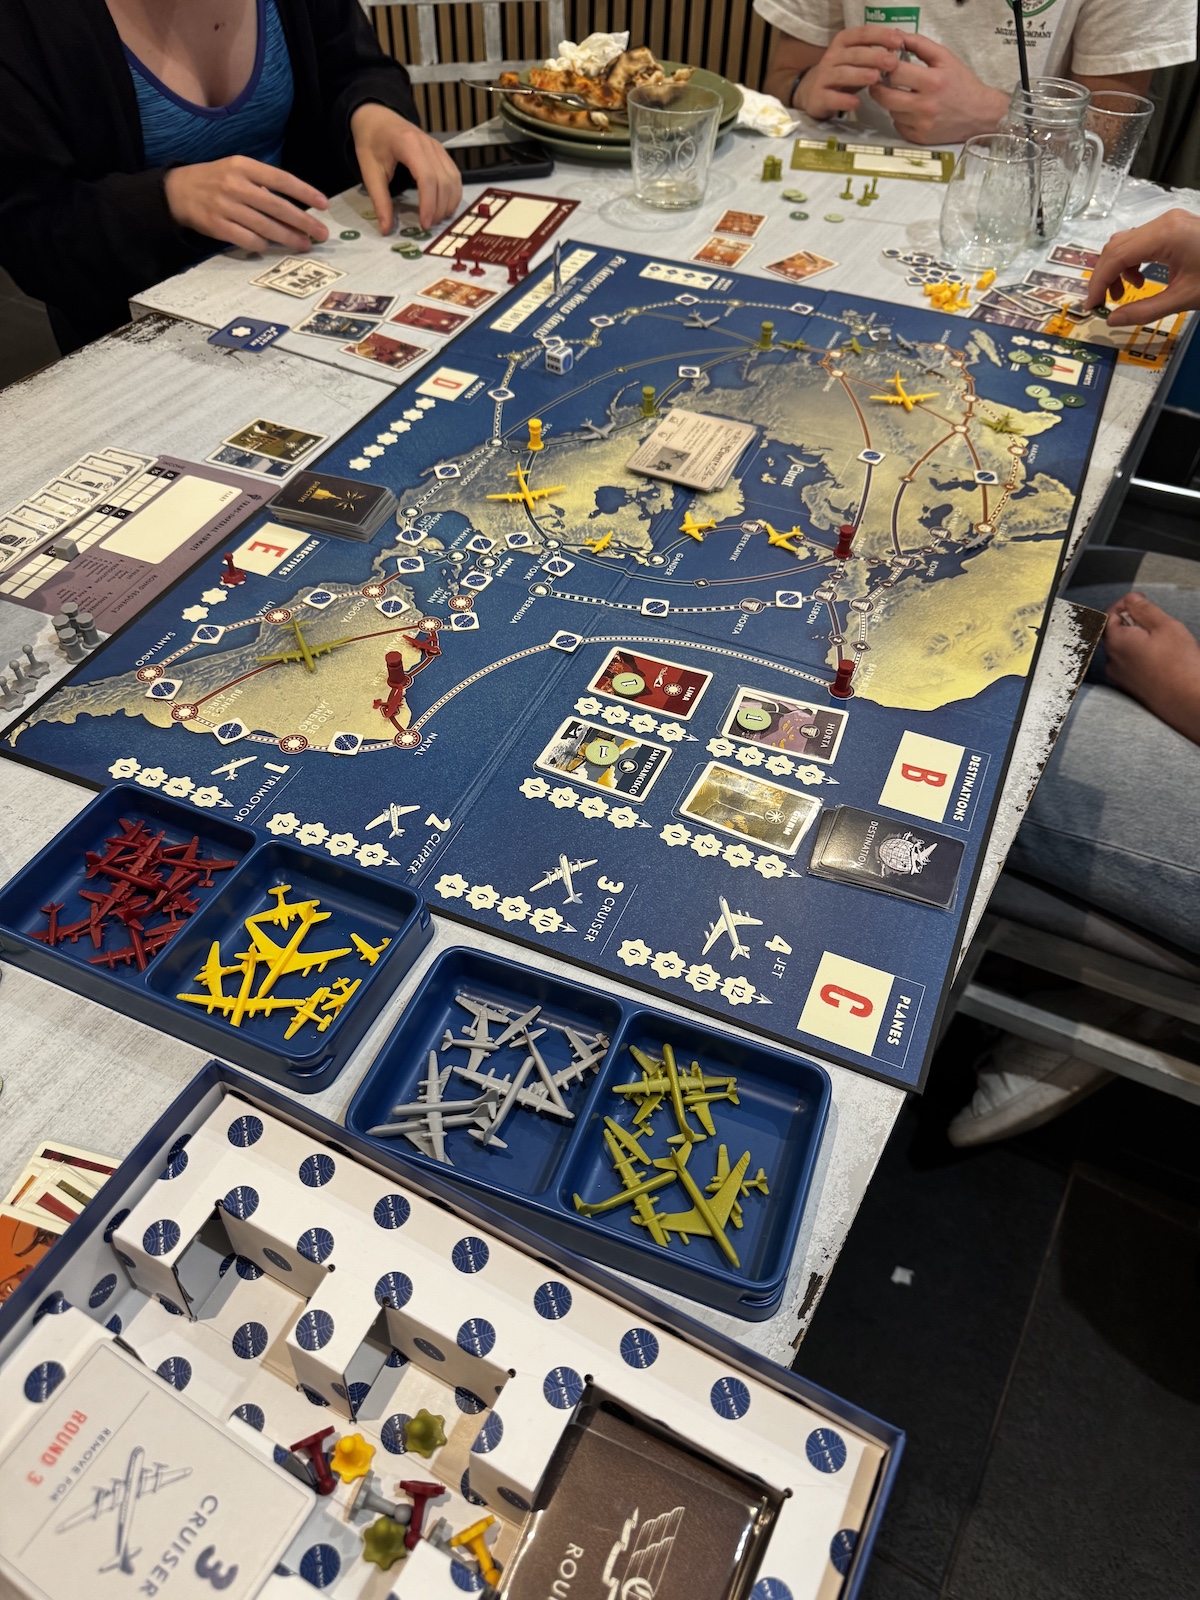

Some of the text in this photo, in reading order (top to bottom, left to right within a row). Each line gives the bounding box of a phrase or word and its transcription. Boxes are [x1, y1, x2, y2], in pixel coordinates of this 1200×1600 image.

[866, 9, 886, 21] hello
[608, 255, 627, 269] PAN
[581, 268, 615, 294] AMERICAN
[560, 295, 588, 315] WORLD
[533, 313, 565, 340] AIRWAYS
[259, 330, 279, 346] FIRST
[432, 377, 464, 390] D
[1083, 365, 1095, 386] AIRPORTS
[464, 381, 486, 400] ROUTES
[290, 439, 316, 458] MIDWAY
[460, 456, 490, 487] FRANCISCO
[781, 463, 806, 488] Event
[298, 481, 321, 504] DIRECTIVE
[190, 501, 251, 552] TRANS-IMPERIAL AIRWAYS
[417, 514, 433, 529] CITY
[422, 512, 443, 535] MEXICO
[448, 527, 471, 550] HAVANA
[248, 541, 289, 558] E
[279, 539, 320, 576] DIRECTIVES
[495, 557, 515, 577] MIAMI
[523, 564, 542, 581] YORK
[664, 553, 684, 576] GANDER
[926, 560, 940, 577] ROME
[139, 574, 158, 591] ROUND
[111, 590, 140, 614] SEQUENCE
[427, 586, 443, 604] JUAN
[437, 591, 451, 605] SAN
[256, 600, 276, 617] LIMA
[509, 597, 536, 624] BERMUDA
[806, 602, 823, 625] LISBON
[871, 597, 888, 623] TANGIER
[732, 614, 749, 635] HORTA
[135, 631, 177, 667] SANTIAGO
[620, 679, 638, 688] 1
[859, 662, 877, 696] BATHURST
[682, 685, 696, 701] LIMA
[202, 692, 226, 718] AIRES
[299, 699, 330, 732] JANEIRO
[307, 709, 334, 736] RIO DE
[610, 711, 622, 719] 2
[745, 712, 764, 722] 1
[637, 720, 649, 728] 4
[666, 728, 678, 736] 6
[820, 722, 836, 749] HORTA
[413, 732, 438, 757] NATAL
[599, 745, 609, 759] 1
[744, 753, 757, 761] 2
[628, 749, 661, 795] SAN FRANCISCO
[774, 762, 785, 771] 4
[804, 771, 817, 779] 6
[901, 762, 948, 788] B
[145, 773, 158, 782] 2
[173, 783, 185, 791] 4
[233, 762, 290, 823] 1 TRIMOTOR
[529, 784, 541, 792] 0
[952, 754, 982, 823] DESTINATIONS
[200, 793, 213, 802] 6
[558, 793, 571, 802] 2
[588, 804, 600, 812] 4
[277, 820, 290, 828] 2
[617, 813, 629, 822] 6
[784, 810, 801, 836] GUAM
[306, 829, 318, 839] 4
[670, 831, 682, 839] 0
[336, 840, 348, 848] 6
[407, 813, 452, 875] 2 CLIPPER
[700, 840, 714, 849] 2
[858, 820, 879, 869] DESTINATION
[366, 850, 379, 859] 8
[732, 851, 744, 860] 4
[764, 862, 777, 871] 6
[445, 881, 457, 891] 4
[476, 893, 489, 902] 6
[508, 904, 522, 913] 8
[583, 875, 625, 943] 3 CRUISER
[538, 913, 554, 928] 10
[628, 948, 641, 957] 6
[764, 934, 793, 979] 4 JET
[662, 960, 676, 970] 8
[695, 971, 711, 986] 10
[730, 984, 746, 999] 12
[819, 983, 875, 1018] C
[886, 994, 912, 1046] PLANES
[242, 1117, 248, 1129] AM
[313, 1155, 319, 1168] AM
[387, 1196, 394, 1209] AM
[158, 1220, 164, 1235] AM
[465, 1238, 477, 1273] PAN AM
[546, 1282, 559, 1319] PAN AM
[309, 1311, 320, 1350] PAN AM
[26, 1410, 88, 1485] ROUND 3
[49, 1427, 112, 1501] REMOVE FOR
[139, 1494, 219, 1597] CRUISER
[195, 1544, 239, 1590] 3
[548, 1542, 584, 1600] ROU
